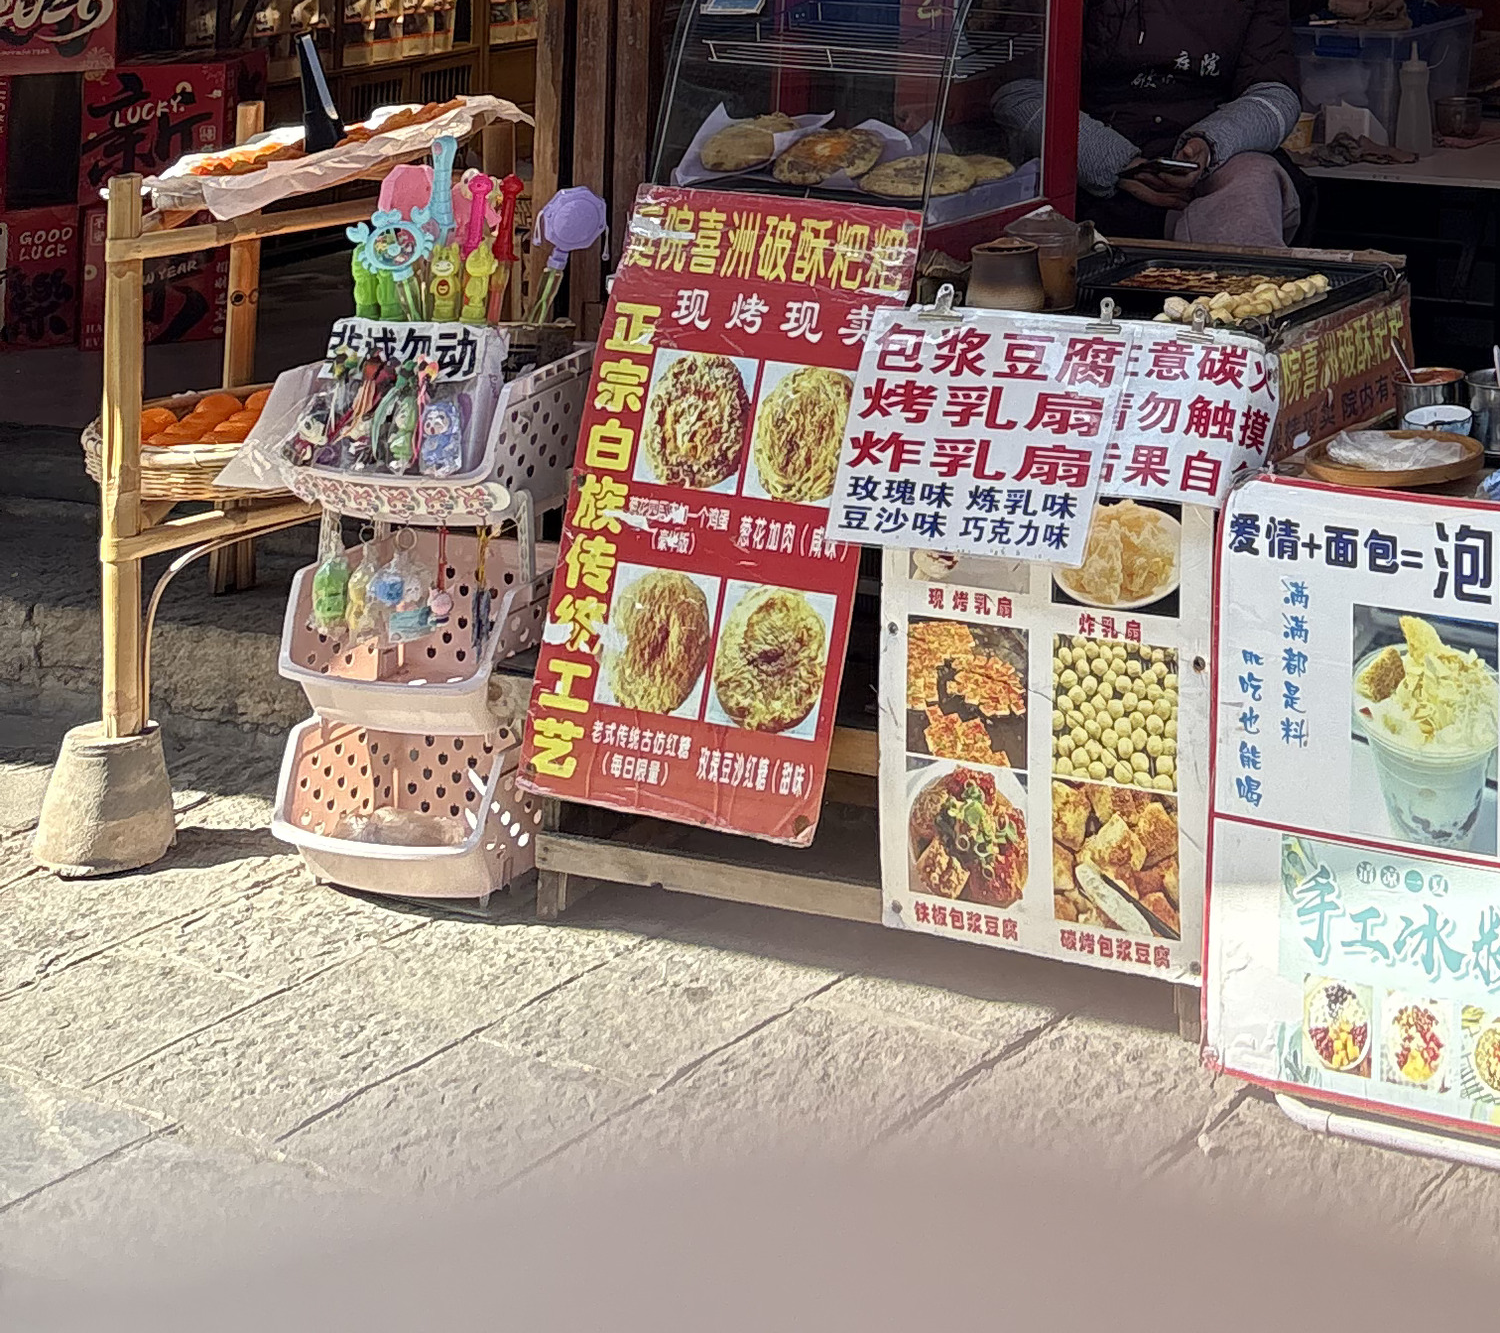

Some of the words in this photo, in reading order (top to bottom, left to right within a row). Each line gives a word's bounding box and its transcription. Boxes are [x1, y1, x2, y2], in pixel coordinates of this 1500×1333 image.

[19, 227, 73, 246] GOOD
[19, 247, 68, 262] LUCK
[875, 324, 1127, 388] 包浆豆腐
[858, 377, 1105, 438] 烤乳扇
[845, 430, 1096, 488] 炸乳扇
[1101, 442, 1248, 498] 果自
[846, 475, 953, 508] 玫瑰味
[968, 484, 1078, 521] 炼乳味
[837, 505, 949, 539] 豆沙味
[959, 516, 1071, 550] 巧克力味
[928, 587, 1014, 620] 现烤乳扇
[1078, 612, 1143, 644] 炸乳扇
[1280, 576, 1310, 749] 满满都是料
[591, 719, 693, 761] 老式传统古仿红糖
[913, 900, 1020, 942] 铁板包浆豆腐
